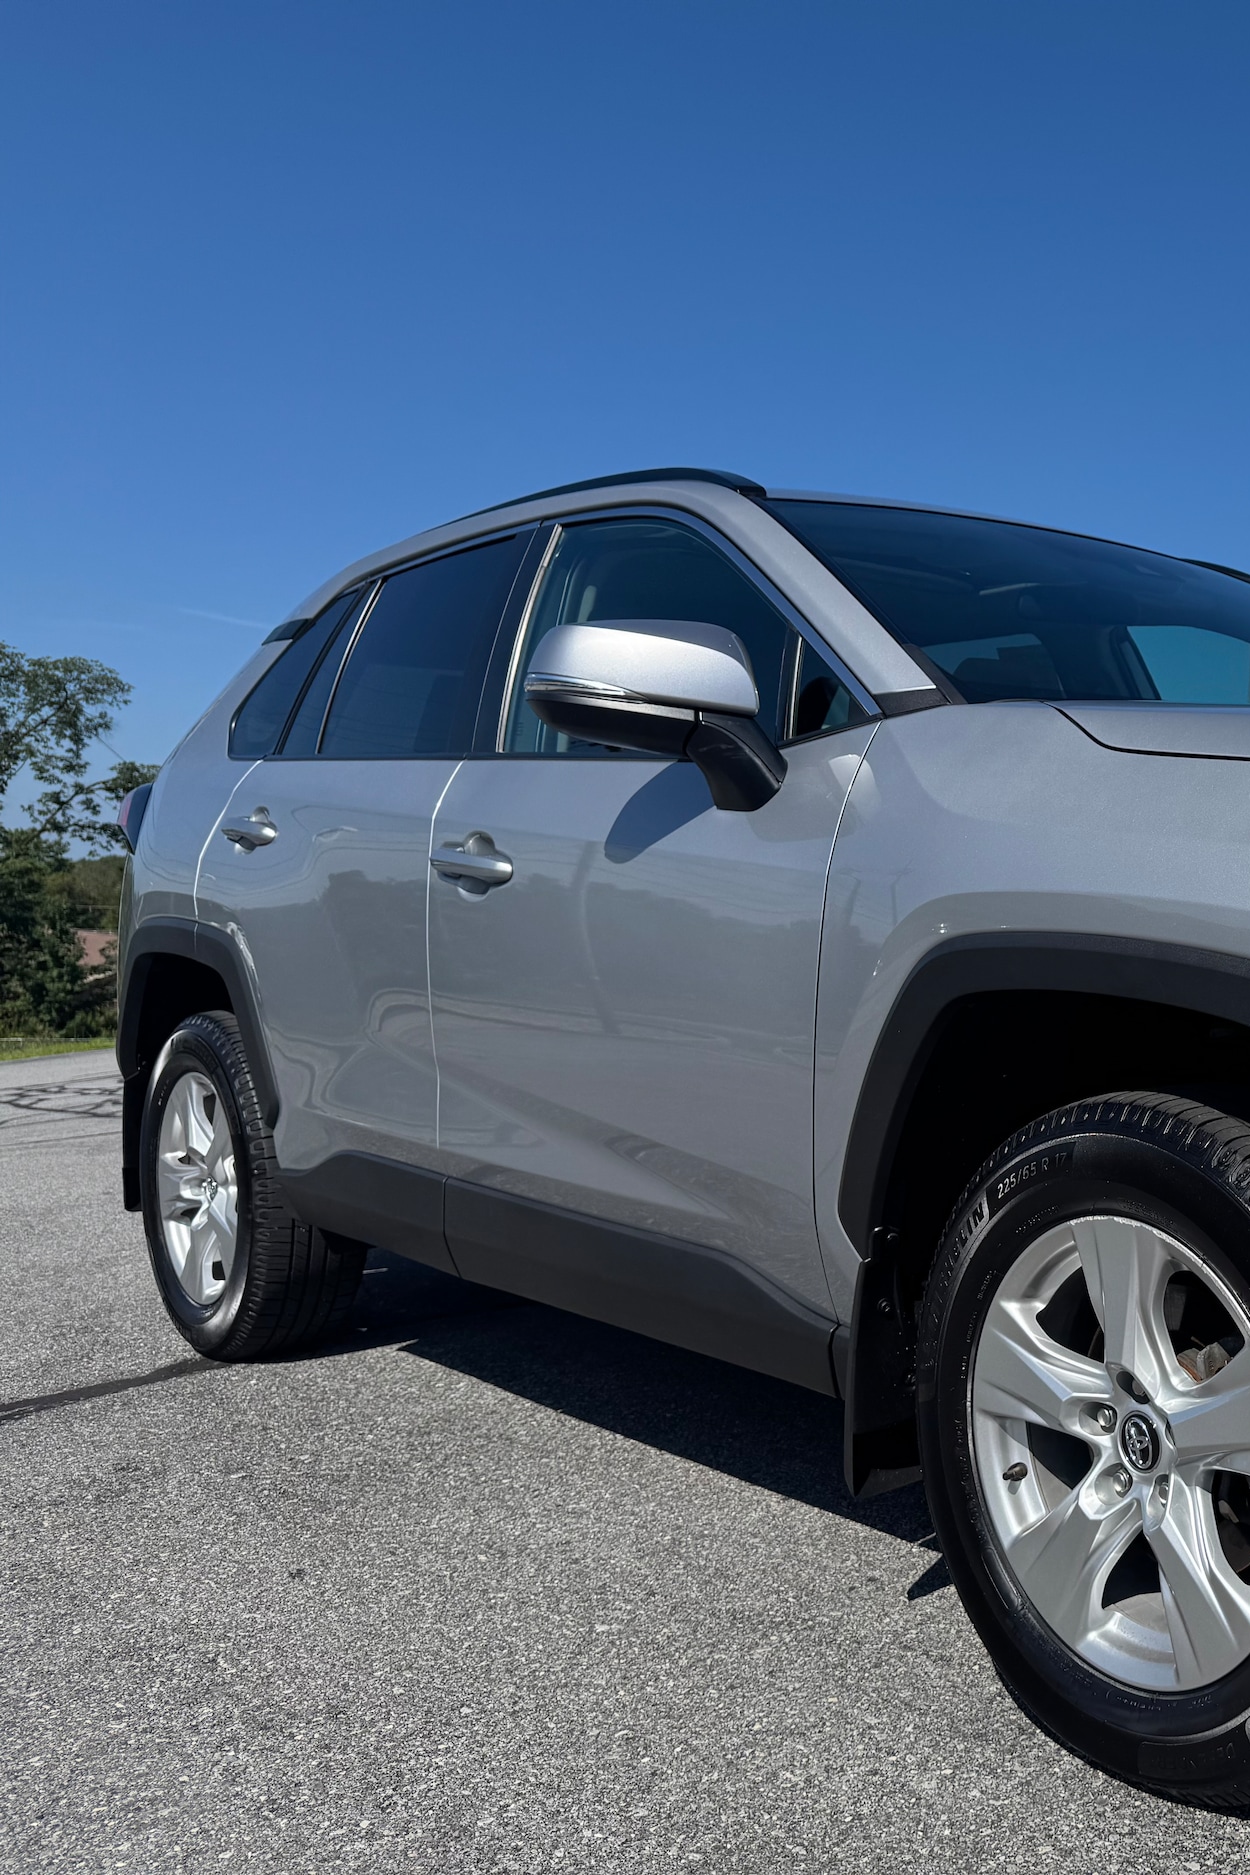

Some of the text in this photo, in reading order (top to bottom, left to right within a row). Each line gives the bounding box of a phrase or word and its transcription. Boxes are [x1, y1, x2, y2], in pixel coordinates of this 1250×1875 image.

[997, 1152, 1067, 1199] 225/65 R 17
